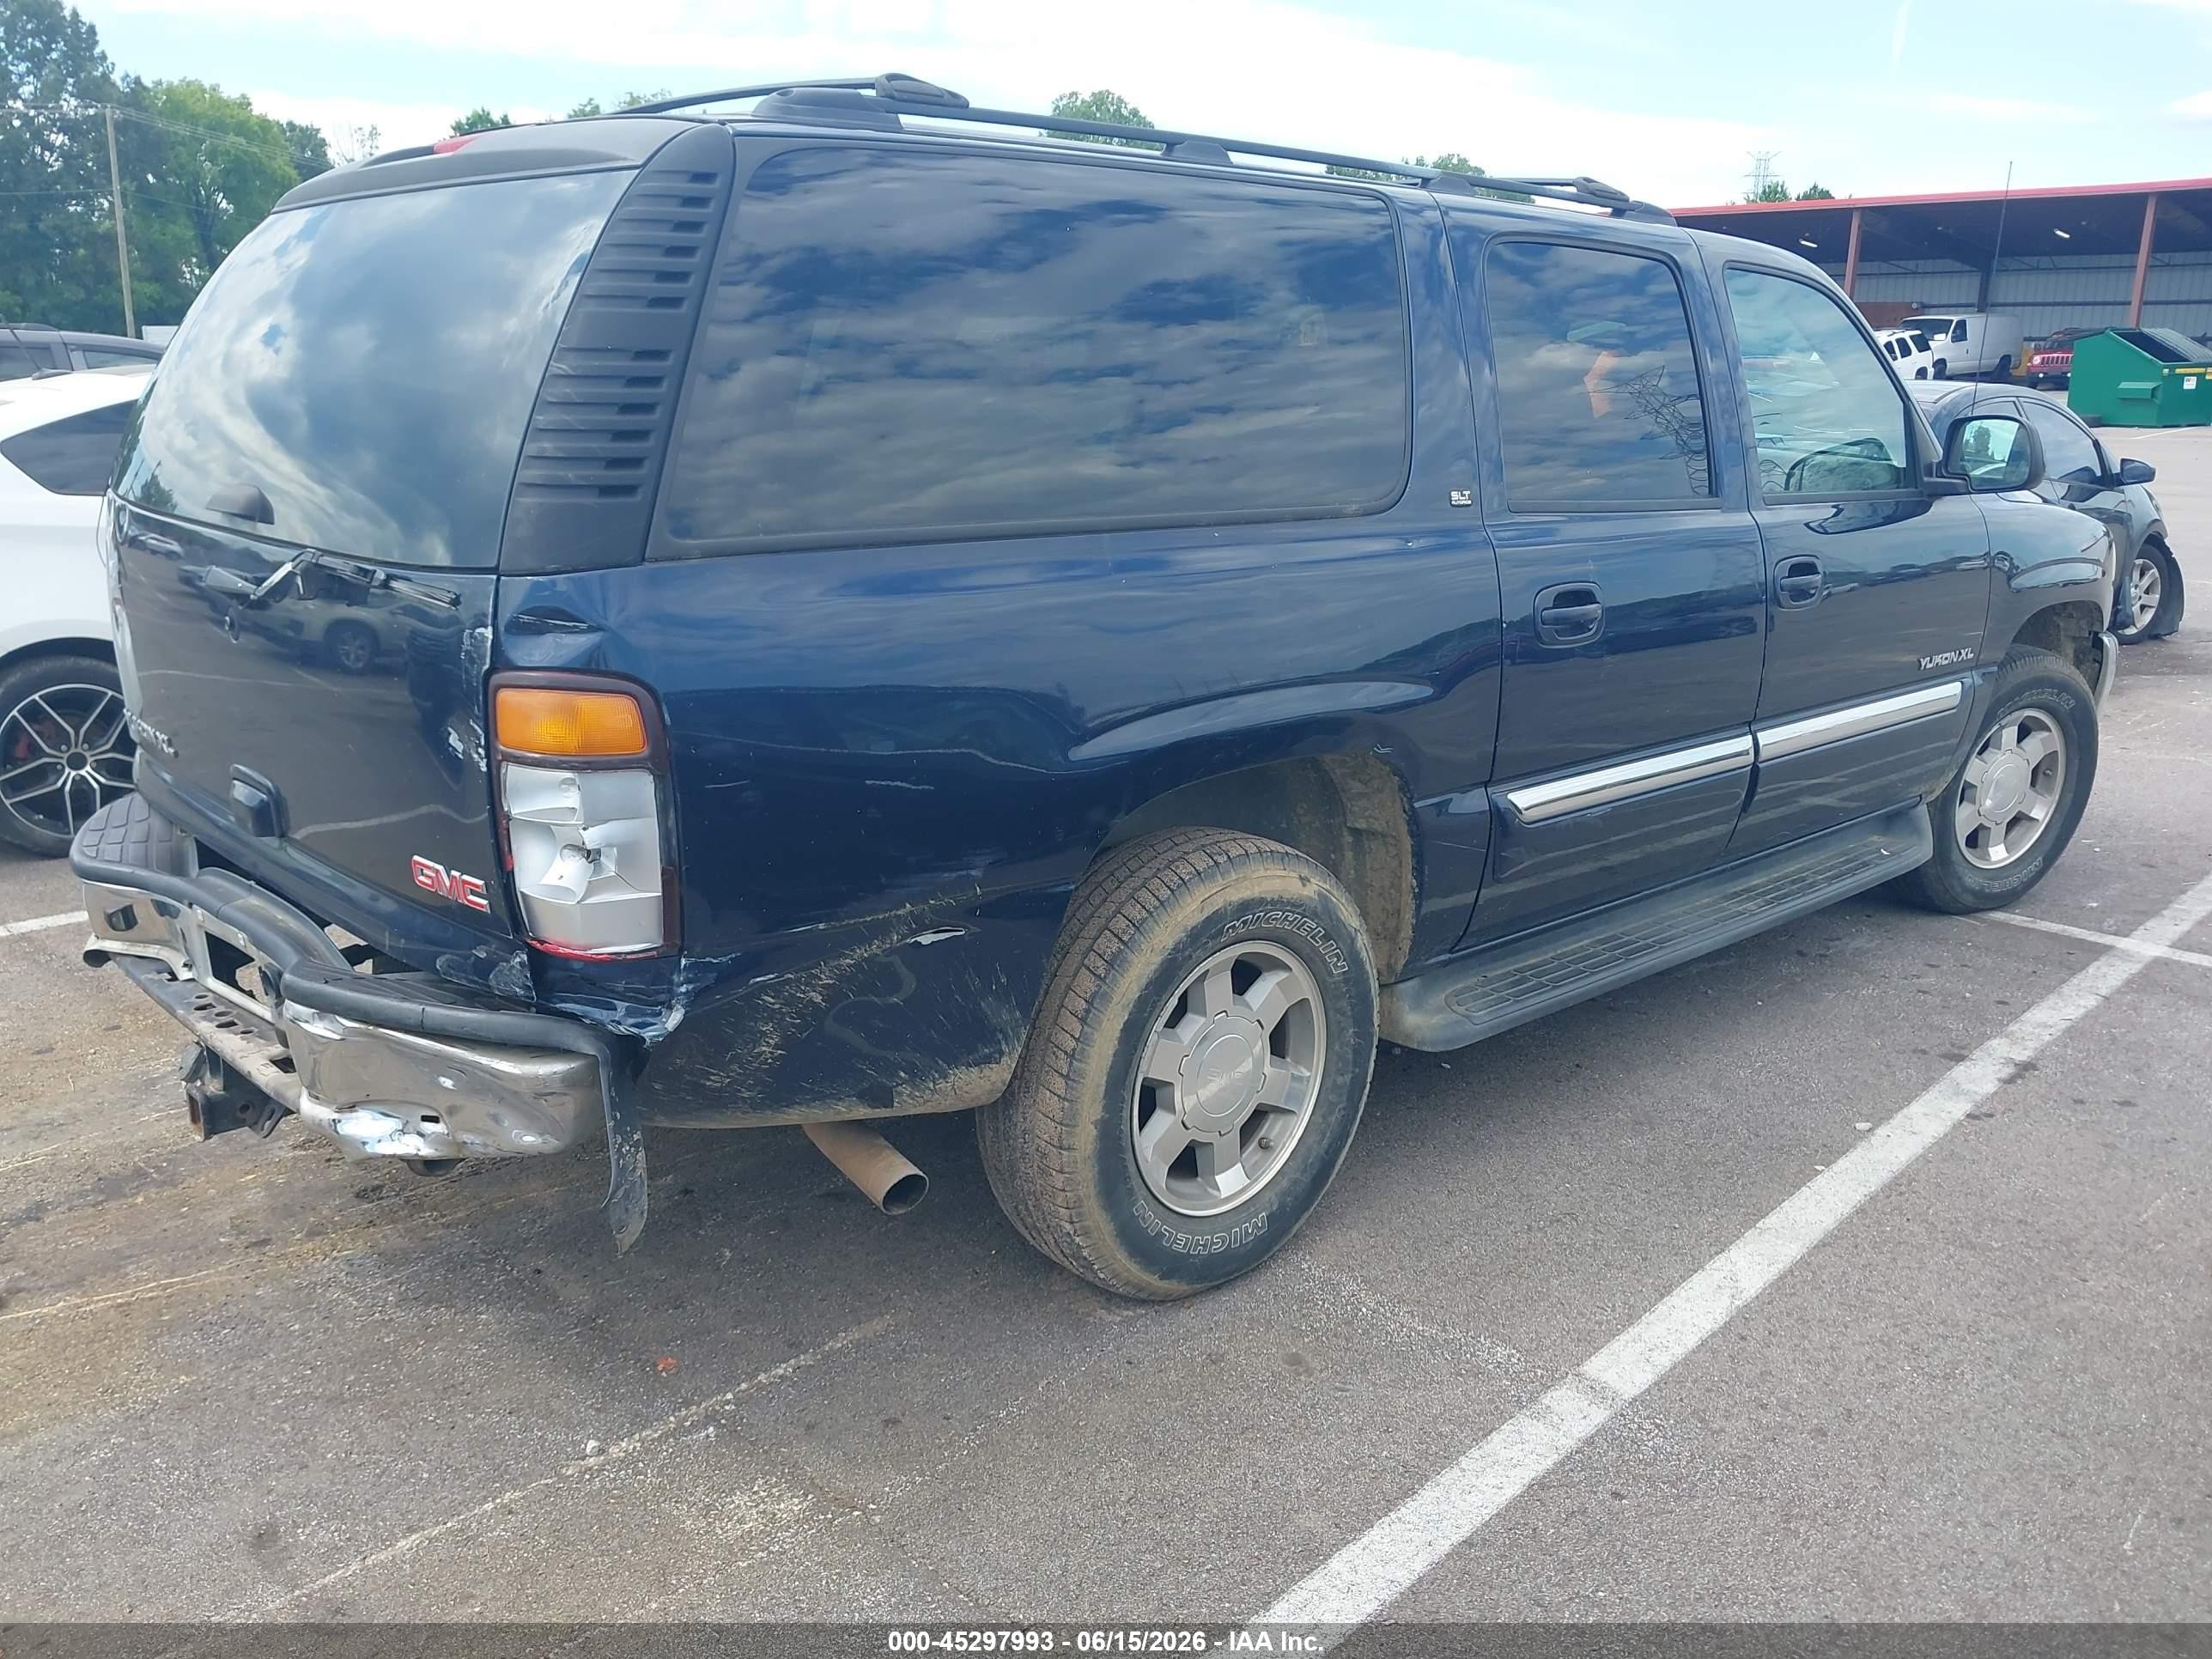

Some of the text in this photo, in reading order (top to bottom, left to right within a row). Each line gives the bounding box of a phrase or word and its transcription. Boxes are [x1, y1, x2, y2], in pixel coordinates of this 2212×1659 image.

[1450, 490, 1470, 501] SLT
[1919, 647, 1974, 670] YUKON XL
[412, 854, 491, 914] GMC
[1966, 857, 2043, 892] MICHEL
[1220, 911, 1349, 974] MICHELIN
[1133, 1200, 1268, 1254] MICHELIN
